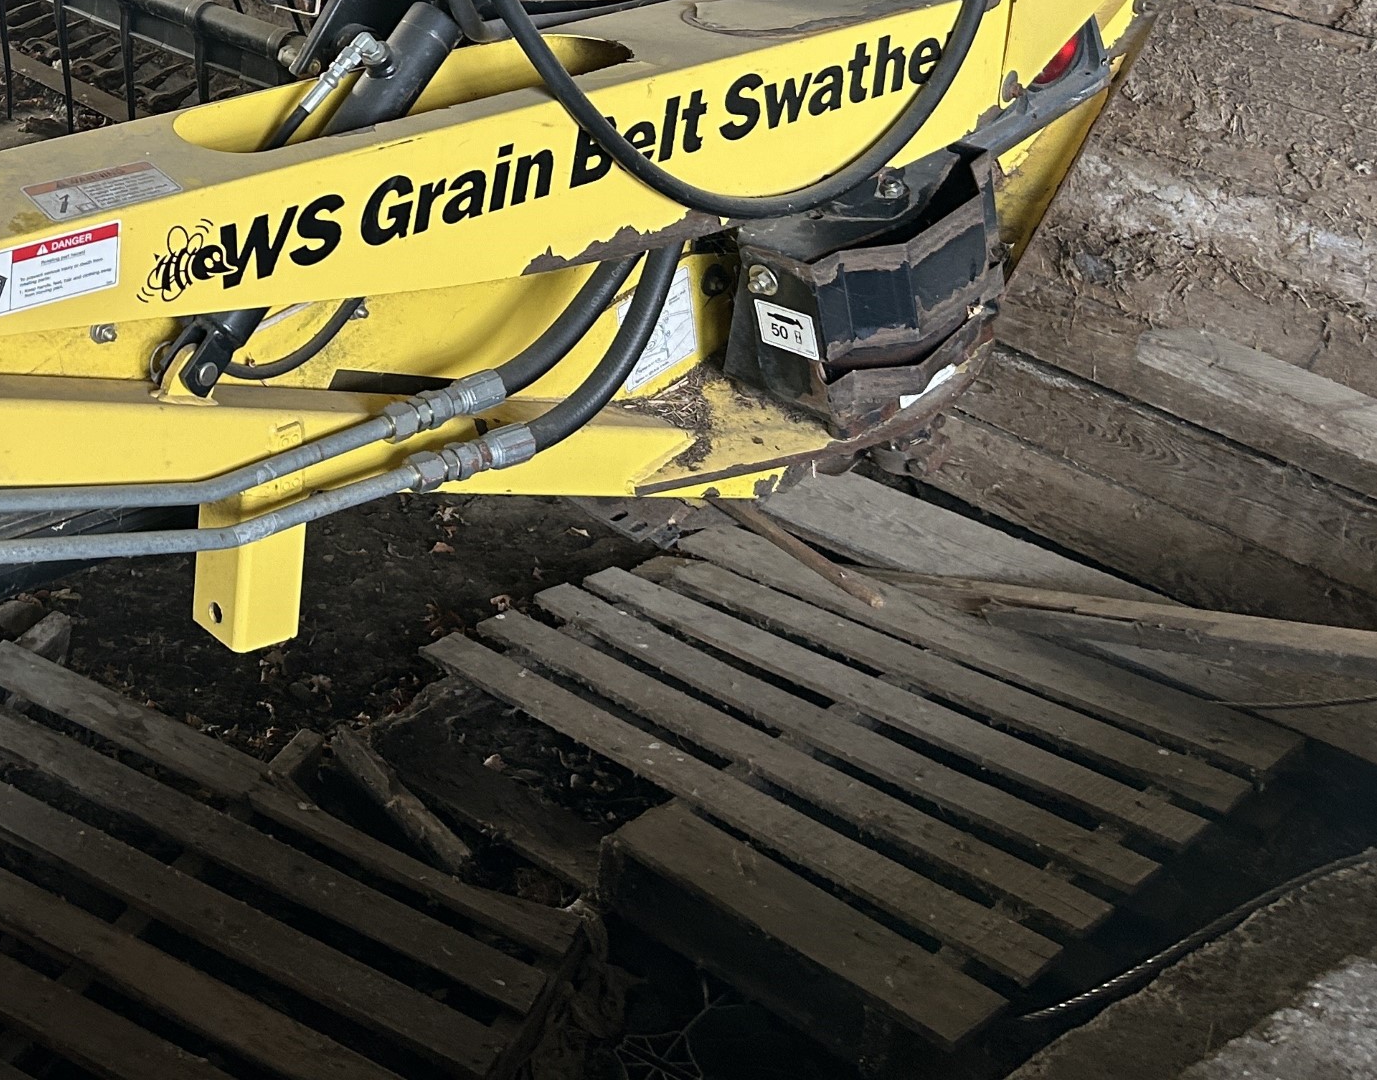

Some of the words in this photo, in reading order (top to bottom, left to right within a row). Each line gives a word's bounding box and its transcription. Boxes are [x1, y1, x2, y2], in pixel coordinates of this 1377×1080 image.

[360, 142, 555, 247] Grain
[718, 29, 954, 141] Swathe
[51, 232, 93, 251] DANGER
[771, 322, 789, 340] 50
